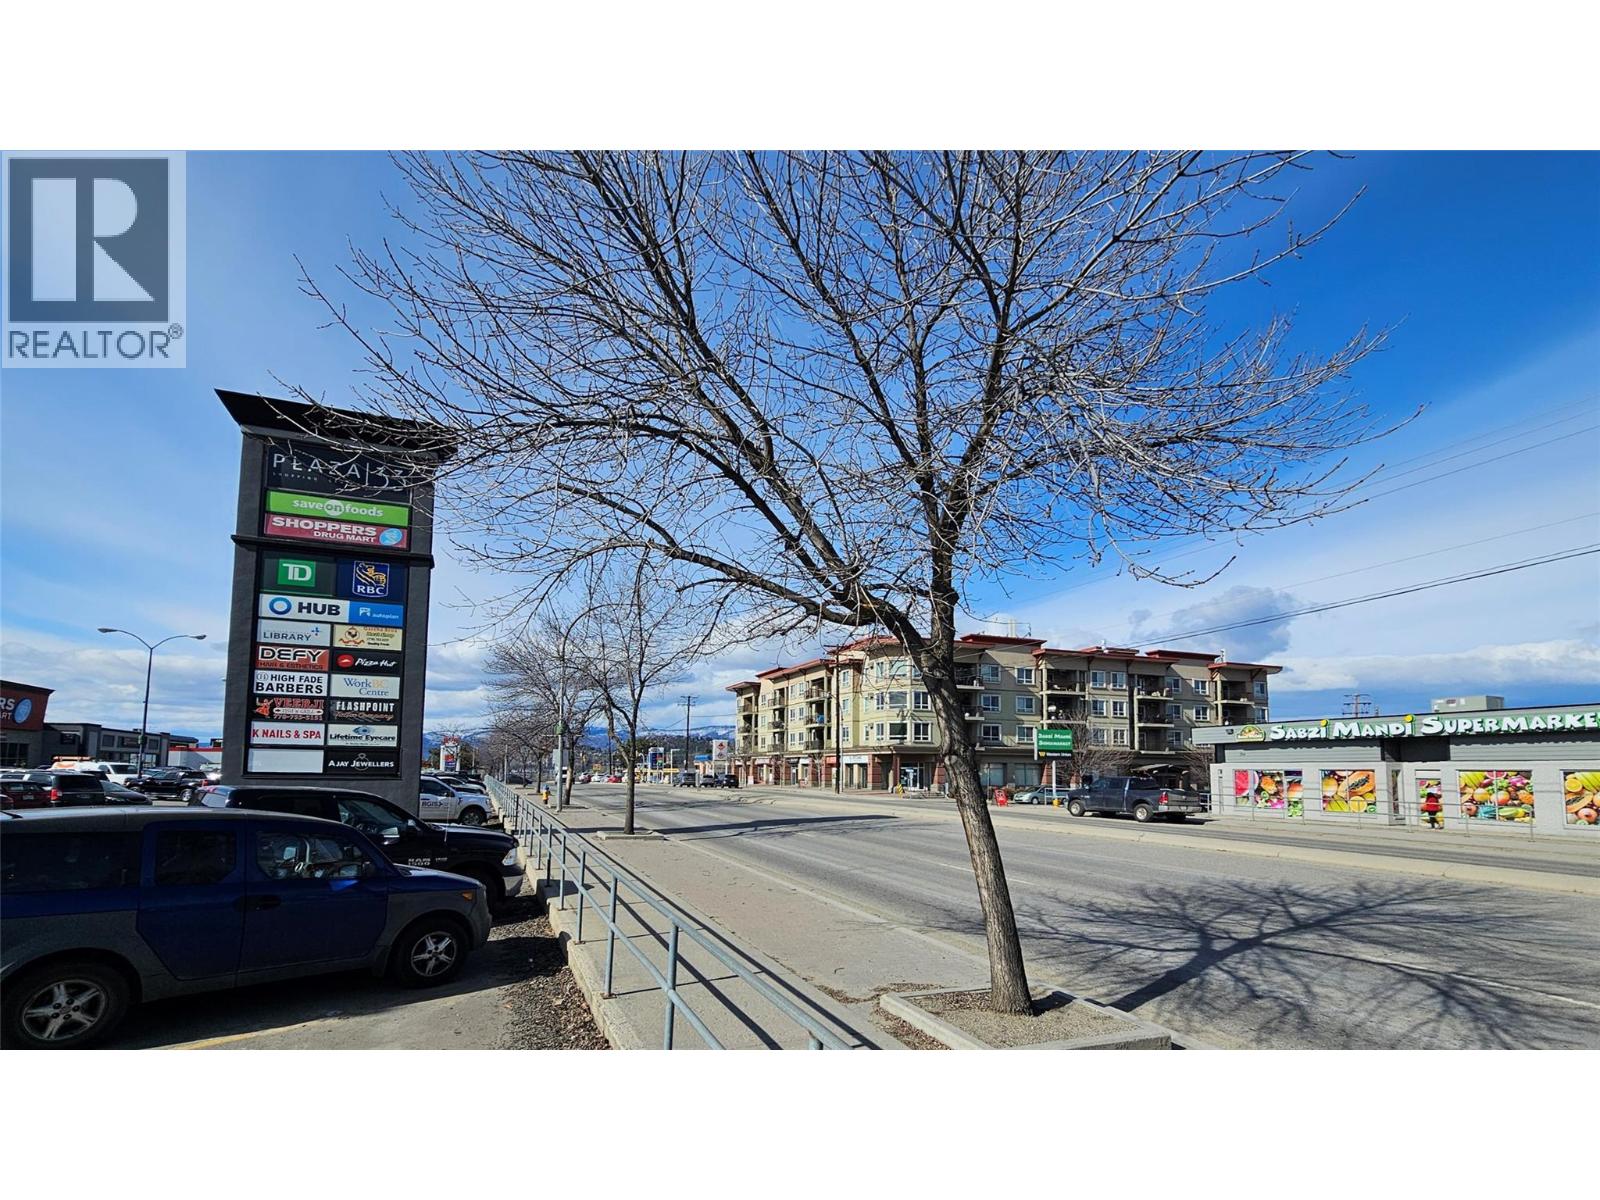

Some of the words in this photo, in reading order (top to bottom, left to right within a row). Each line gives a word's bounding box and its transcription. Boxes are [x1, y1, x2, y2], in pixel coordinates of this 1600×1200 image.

[272, 453, 361, 479] PLAZA
[272, 516, 377, 536] SHOPPERS
[313, 530, 344, 540] DRUG
[345, 534, 377, 543] MART
[282, 563, 312, 581] TD
[357, 584, 385, 595] RBC
[297, 601, 341, 616] HUB
[263, 631, 312, 641] LIBRARY
[259, 646, 324, 664] DEFY
[355, 658, 379, 667] Pizza
[380, 659, 397, 667] Hut
[270, 673, 295, 682] HIGH
[299, 675, 323, 683] FADE
[255, 681, 323, 694] BARBERS
[359, 688, 390, 697] Centre
[336, 701, 395, 712] FLASHPOINT
[1420, 710, 1600, 737] SUPERMARKE
[262, 729, 291, 738] NAILS
[293, 730, 300, 738] &
[302, 730, 321, 739] SPA
[350, 760, 395, 768] JEWELLERS
